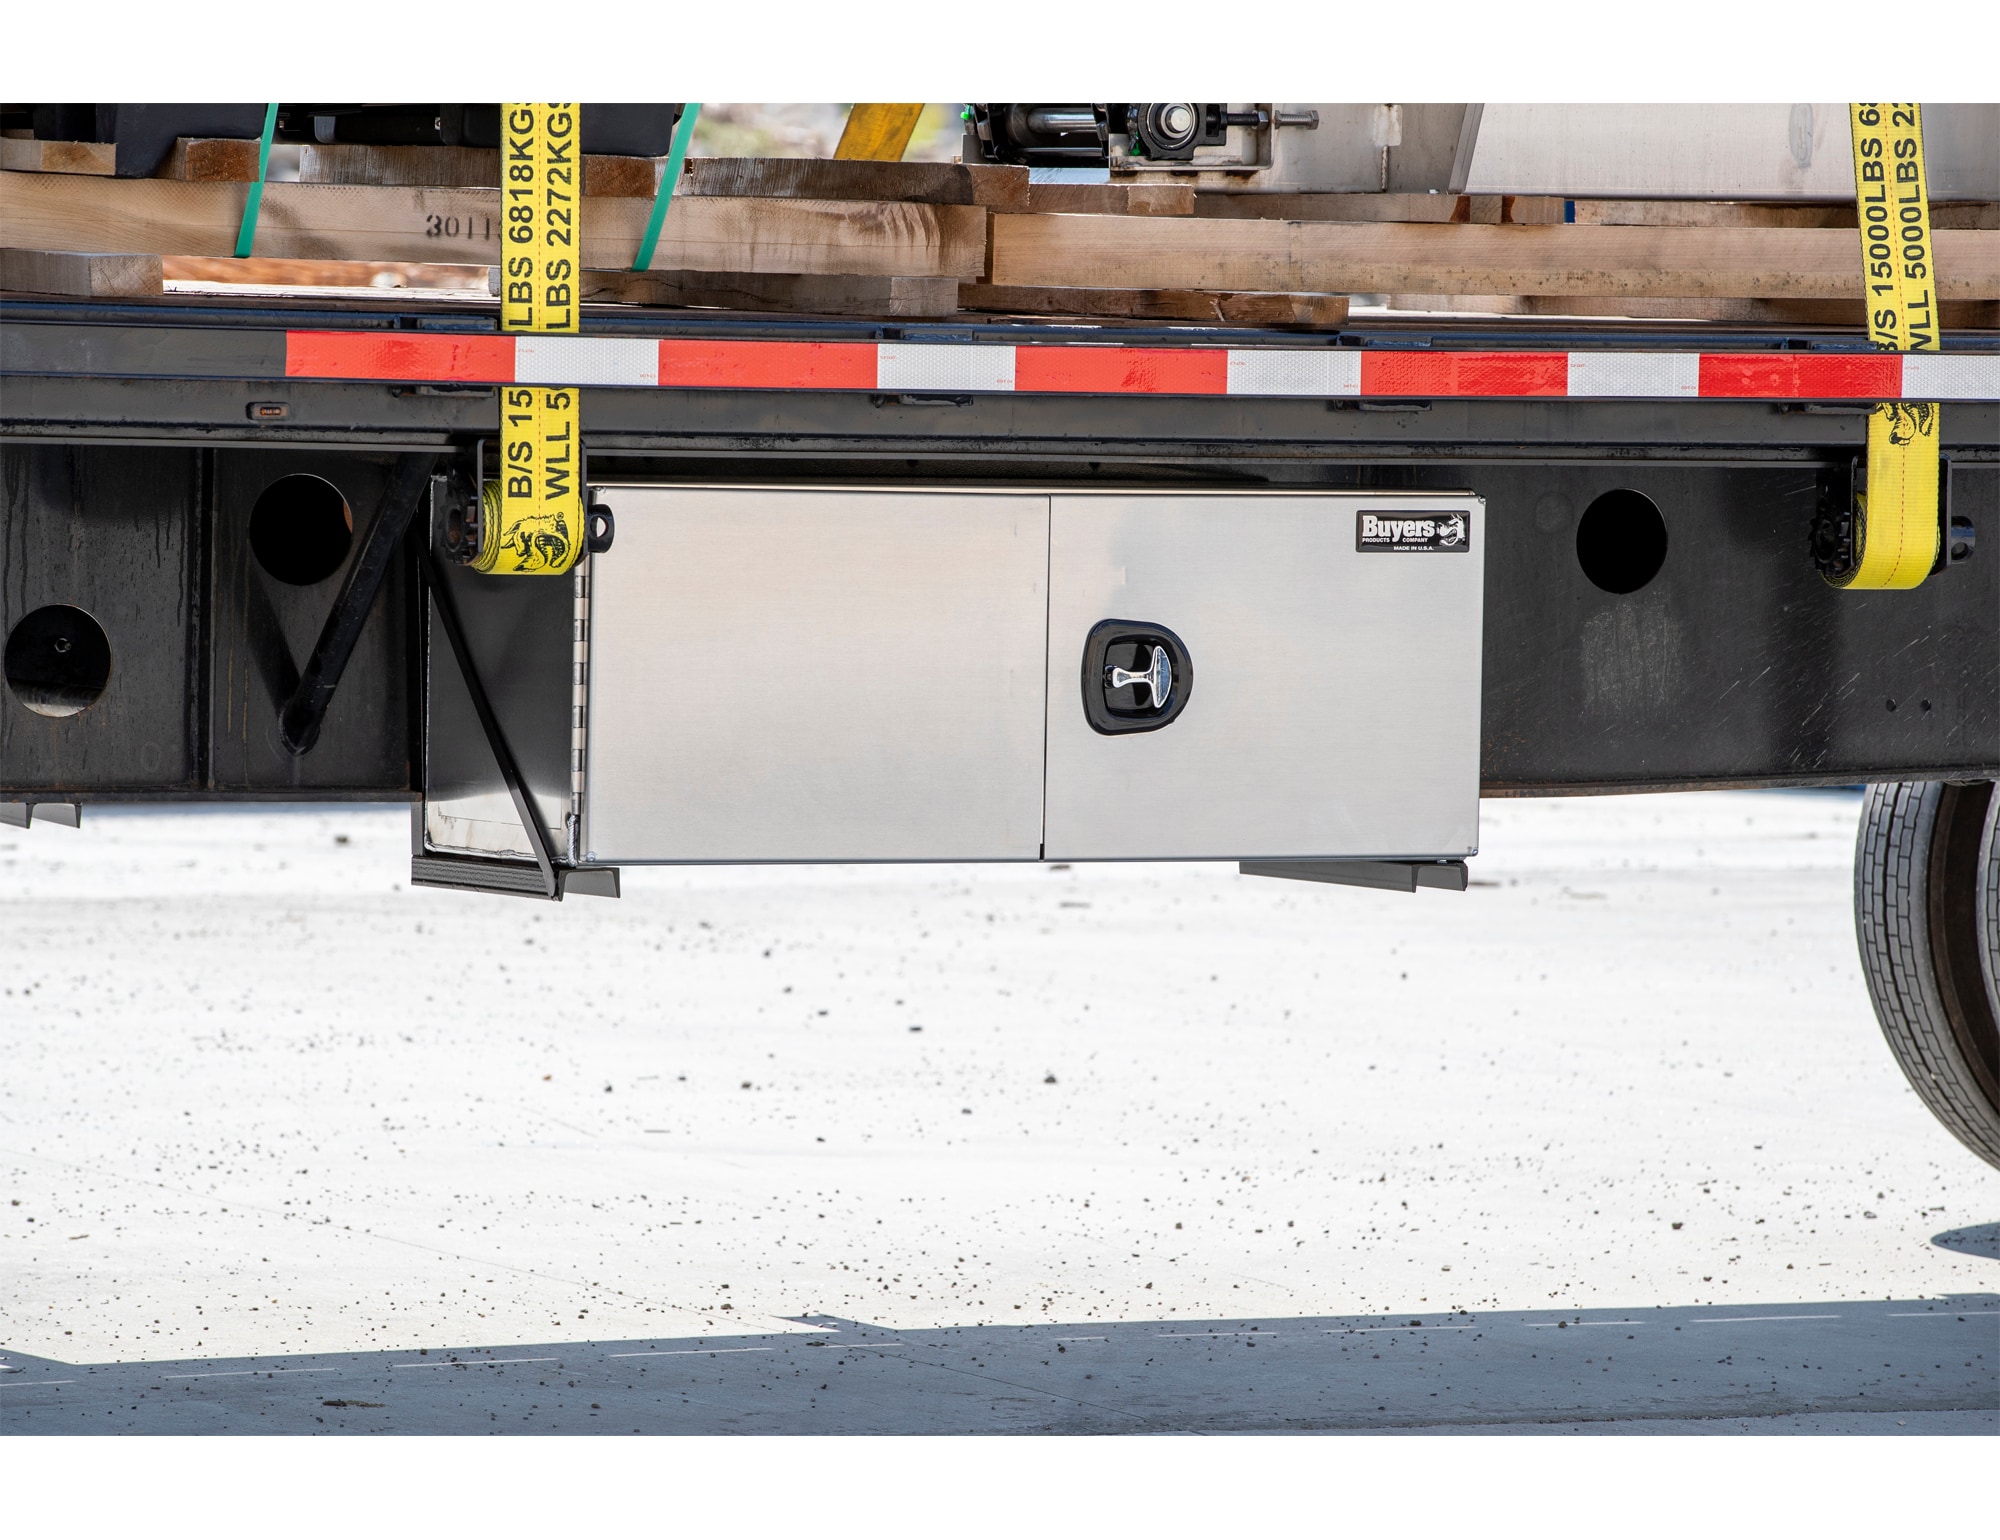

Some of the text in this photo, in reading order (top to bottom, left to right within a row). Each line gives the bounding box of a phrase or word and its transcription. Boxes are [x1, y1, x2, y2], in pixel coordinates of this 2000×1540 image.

[1858, 103, 1881, 126] 6
[1892, 103, 1915, 127] 2
[508, 103, 534, 244] 6818KG
[426, 214, 501, 241] 3011
[1861, 138, 1894, 296] 15000LBS
[1893, 138, 1927, 279] 5000LBS
[508, 441, 533, 498] B/S
[545, 421, 571, 500] WLL
[1362, 515, 1435, 542] Buyers
